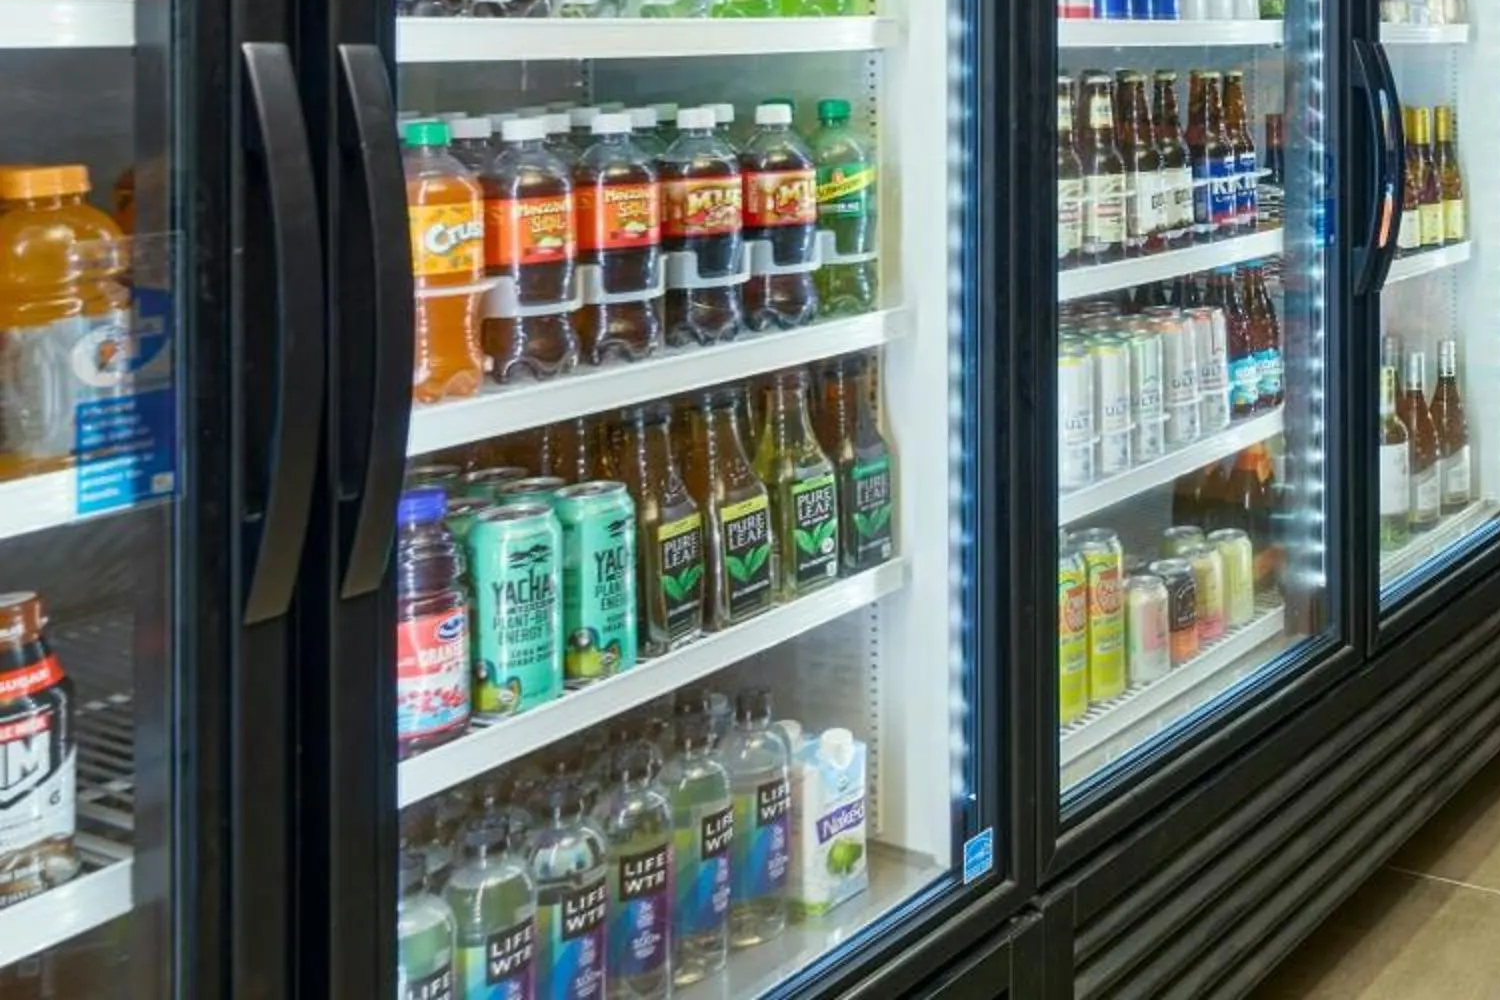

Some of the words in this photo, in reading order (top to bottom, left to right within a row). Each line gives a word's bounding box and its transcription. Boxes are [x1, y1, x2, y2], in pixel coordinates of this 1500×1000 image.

[624, 853, 666, 879] LIFE
[624, 870, 666, 896] WTR
[567, 884, 606, 914] LIFE
[566, 902, 606, 933] WTR
[489, 924, 533, 957] LIFE
[490, 944, 533, 977] WTR
